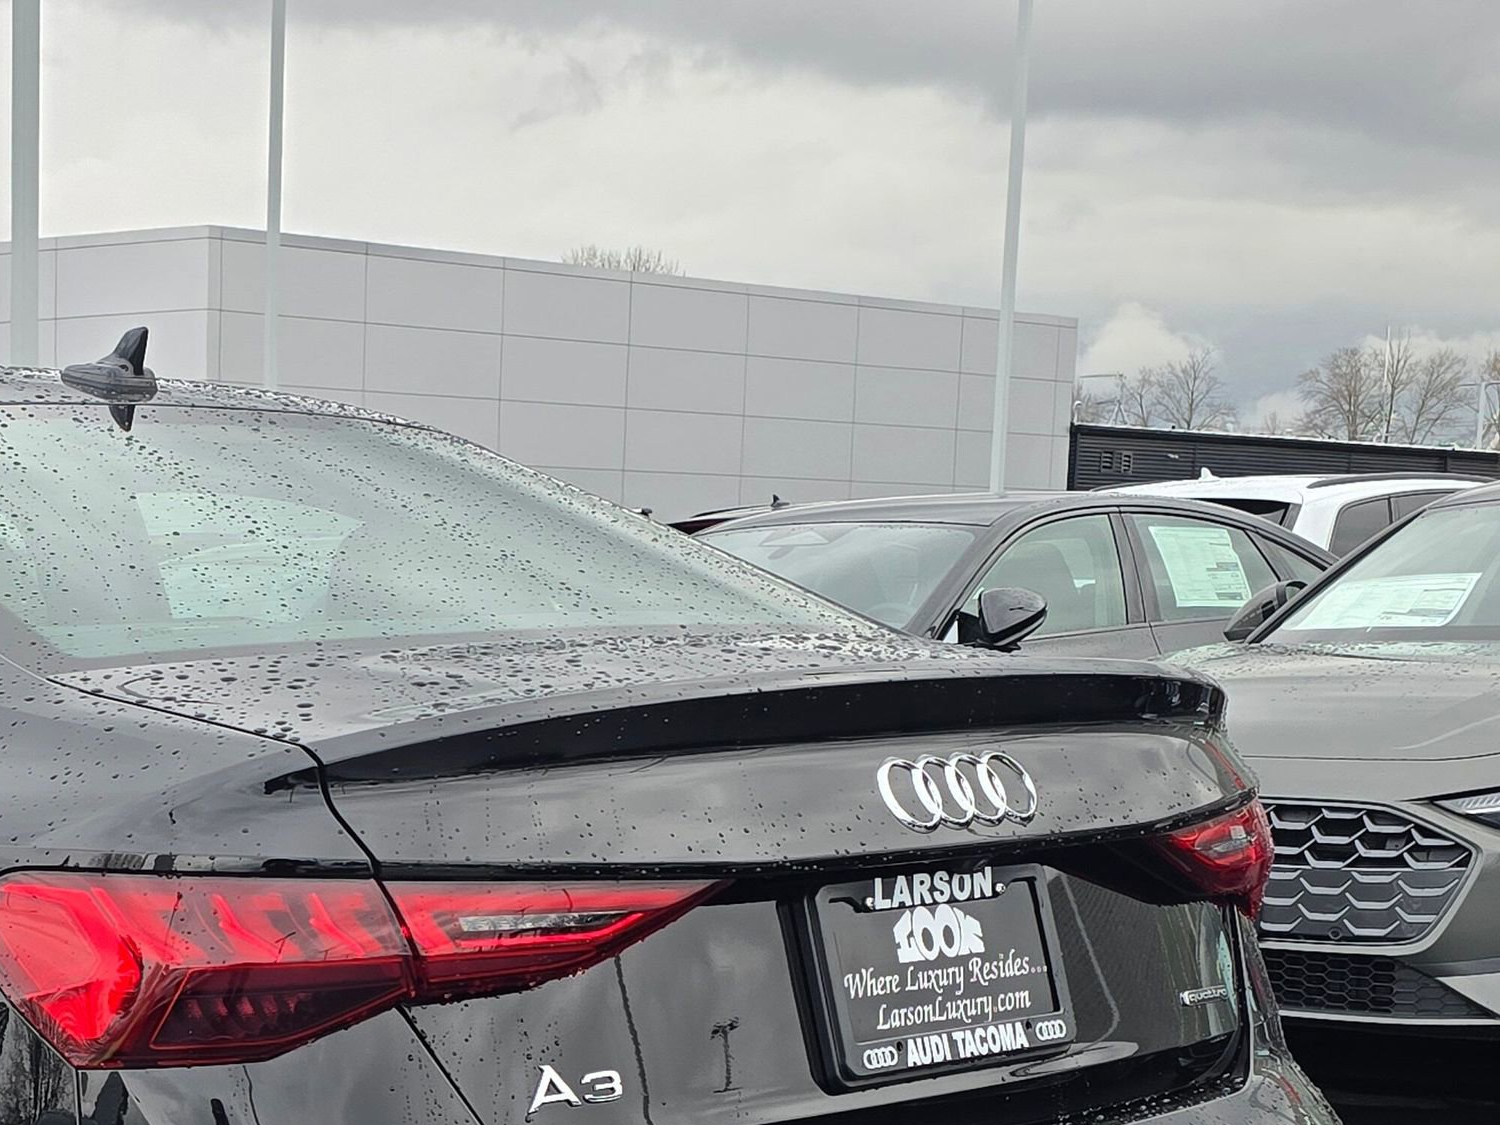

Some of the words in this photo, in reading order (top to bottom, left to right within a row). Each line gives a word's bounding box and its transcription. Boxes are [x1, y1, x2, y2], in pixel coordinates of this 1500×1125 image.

[874, 866, 993, 910] LARSON
[892, 903, 986, 964] LOOK
[843, 966, 901, 1000] Where
[905, 965, 964, 996] Luxury
[1188, 987, 1228, 1003] quattro
[876, 989, 1032, 1030] LarsonLuxury.com
[906, 1036, 950, 1068] AUDI
[951, 1021, 1030, 1058] TACOMA
[528, 1064, 623, 1114] A3
